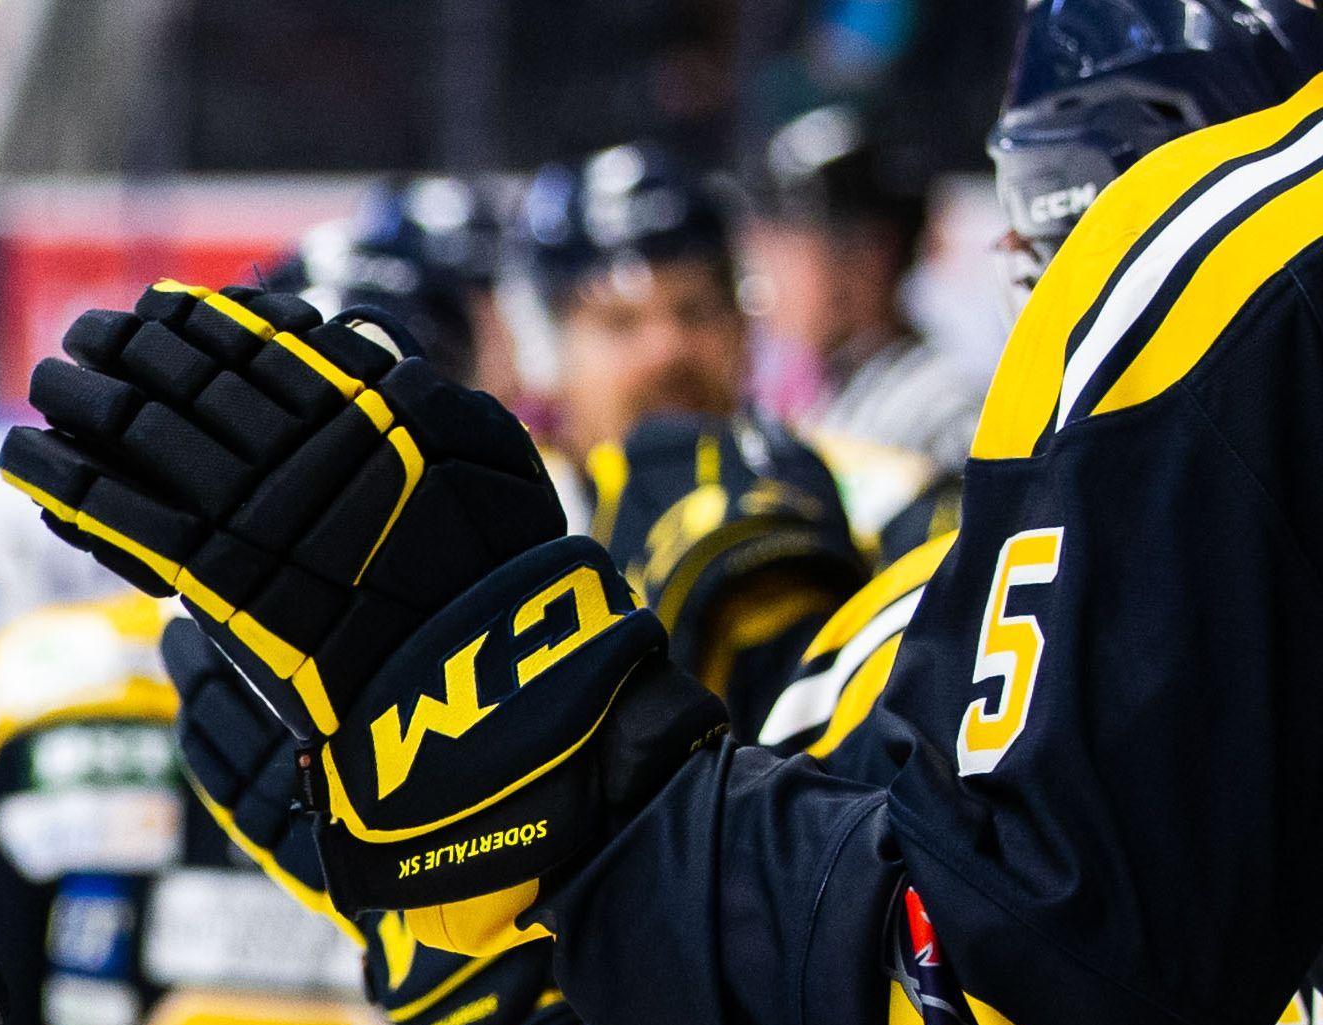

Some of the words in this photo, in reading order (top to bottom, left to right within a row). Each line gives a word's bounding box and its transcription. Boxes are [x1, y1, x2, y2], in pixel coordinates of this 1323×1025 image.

[370, 565, 643, 801] CM
[956, 526, 1065, 778] 5
[397, 854, 422, 879] SK
[424, 819, 548, 871] SÖDERTÄLJE
